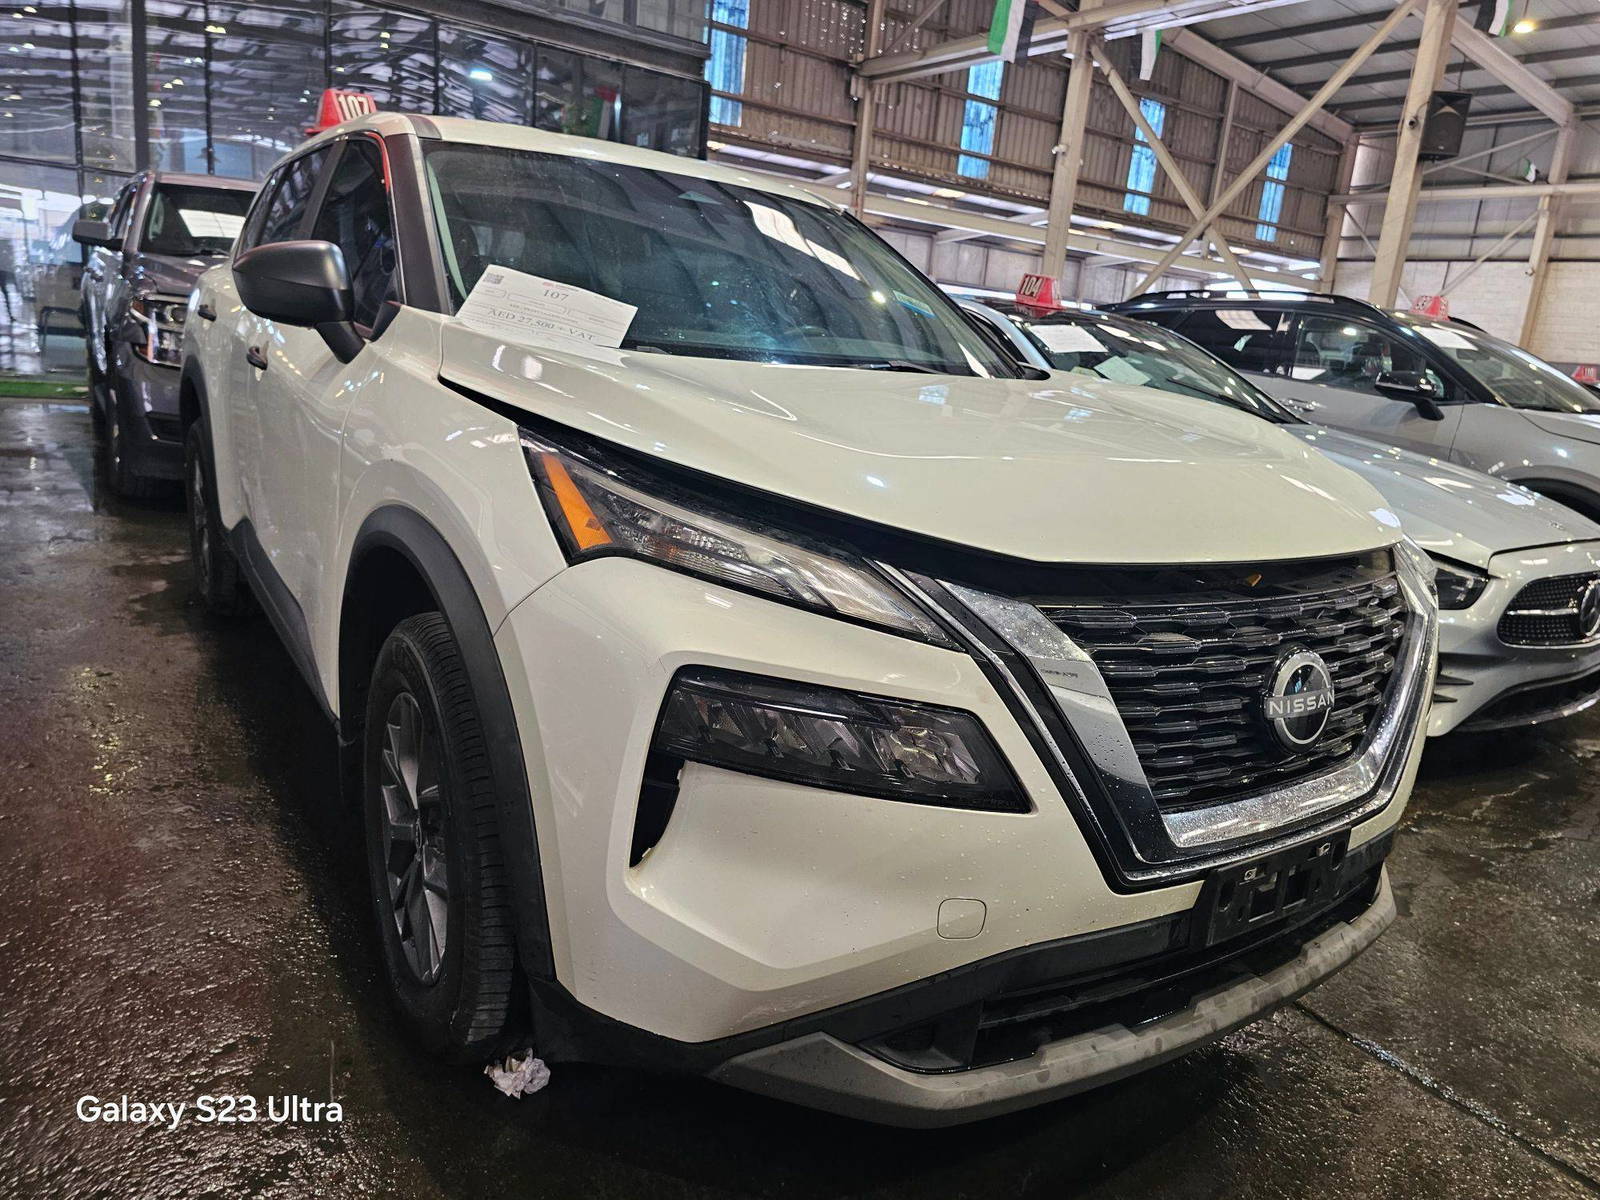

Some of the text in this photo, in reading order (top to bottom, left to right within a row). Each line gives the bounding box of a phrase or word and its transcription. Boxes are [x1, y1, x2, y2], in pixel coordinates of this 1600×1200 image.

[338, 94, 370, 121] 107
[544, 290, 569, 301] 107
[1020, 276, 1042, 297] 104
[487, 309, 516, 320] AED
[568, 328, 596, 341] VAT
[1269, 690, 1334, 714] NISSAN
